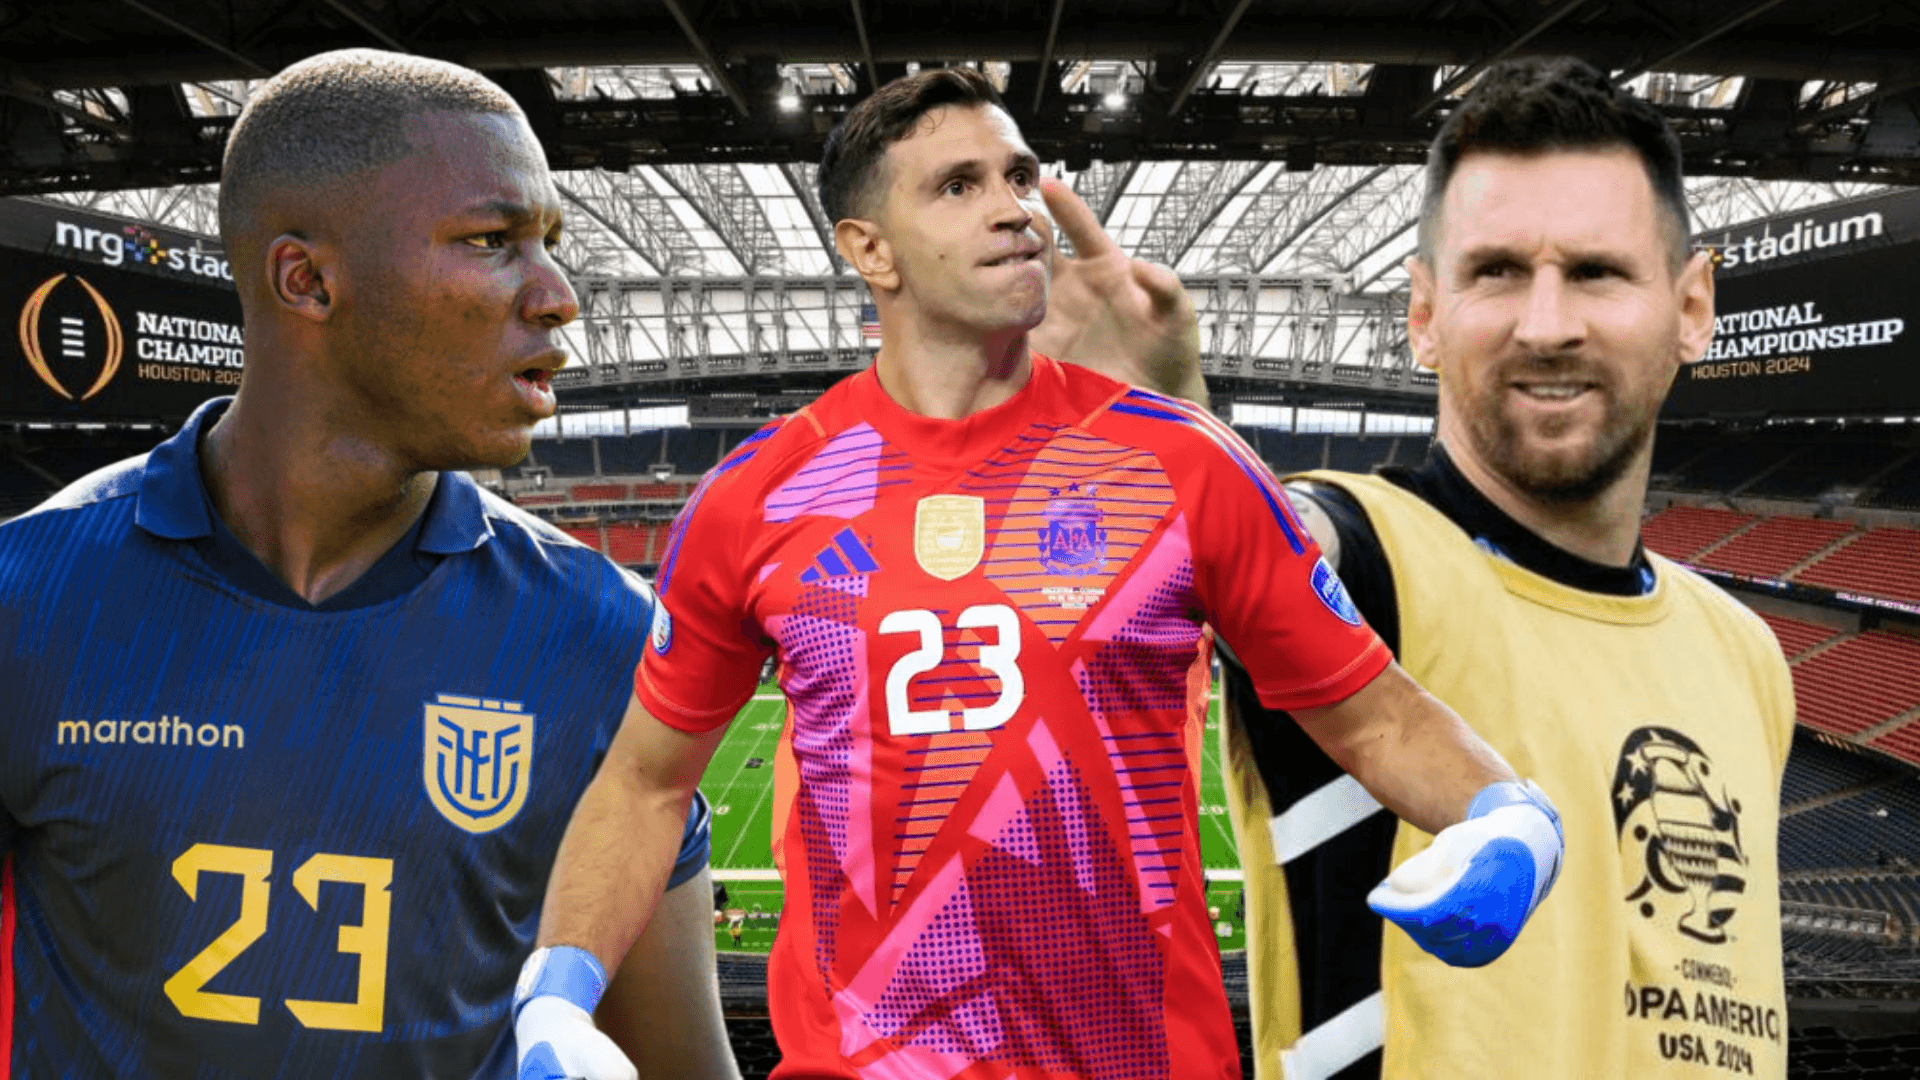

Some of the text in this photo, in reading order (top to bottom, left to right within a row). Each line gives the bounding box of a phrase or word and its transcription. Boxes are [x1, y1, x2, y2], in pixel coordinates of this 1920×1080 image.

[56, 220, 124, 267] nrg
[1722, 211, 1884, 269] stadium
[136, 311, 244, 345] NATIONA
[1704, 318, 1904, 360] HAMPIONSHIP
[1713, 302, 1823, 336] ATIONAL
[138, 363, 211, 383] HOUSTON
[1691, 357, 1810, 380] HOUSTON 2024
[878, 603, 1026, 736] 23
[57, 715, 245, 748] marathon
[163, 843, 394, 1033] 23
[1625, 980, 1781, 1046] OPA AMERIC
[1658, 1032, 1754, 1076] USA 2024
